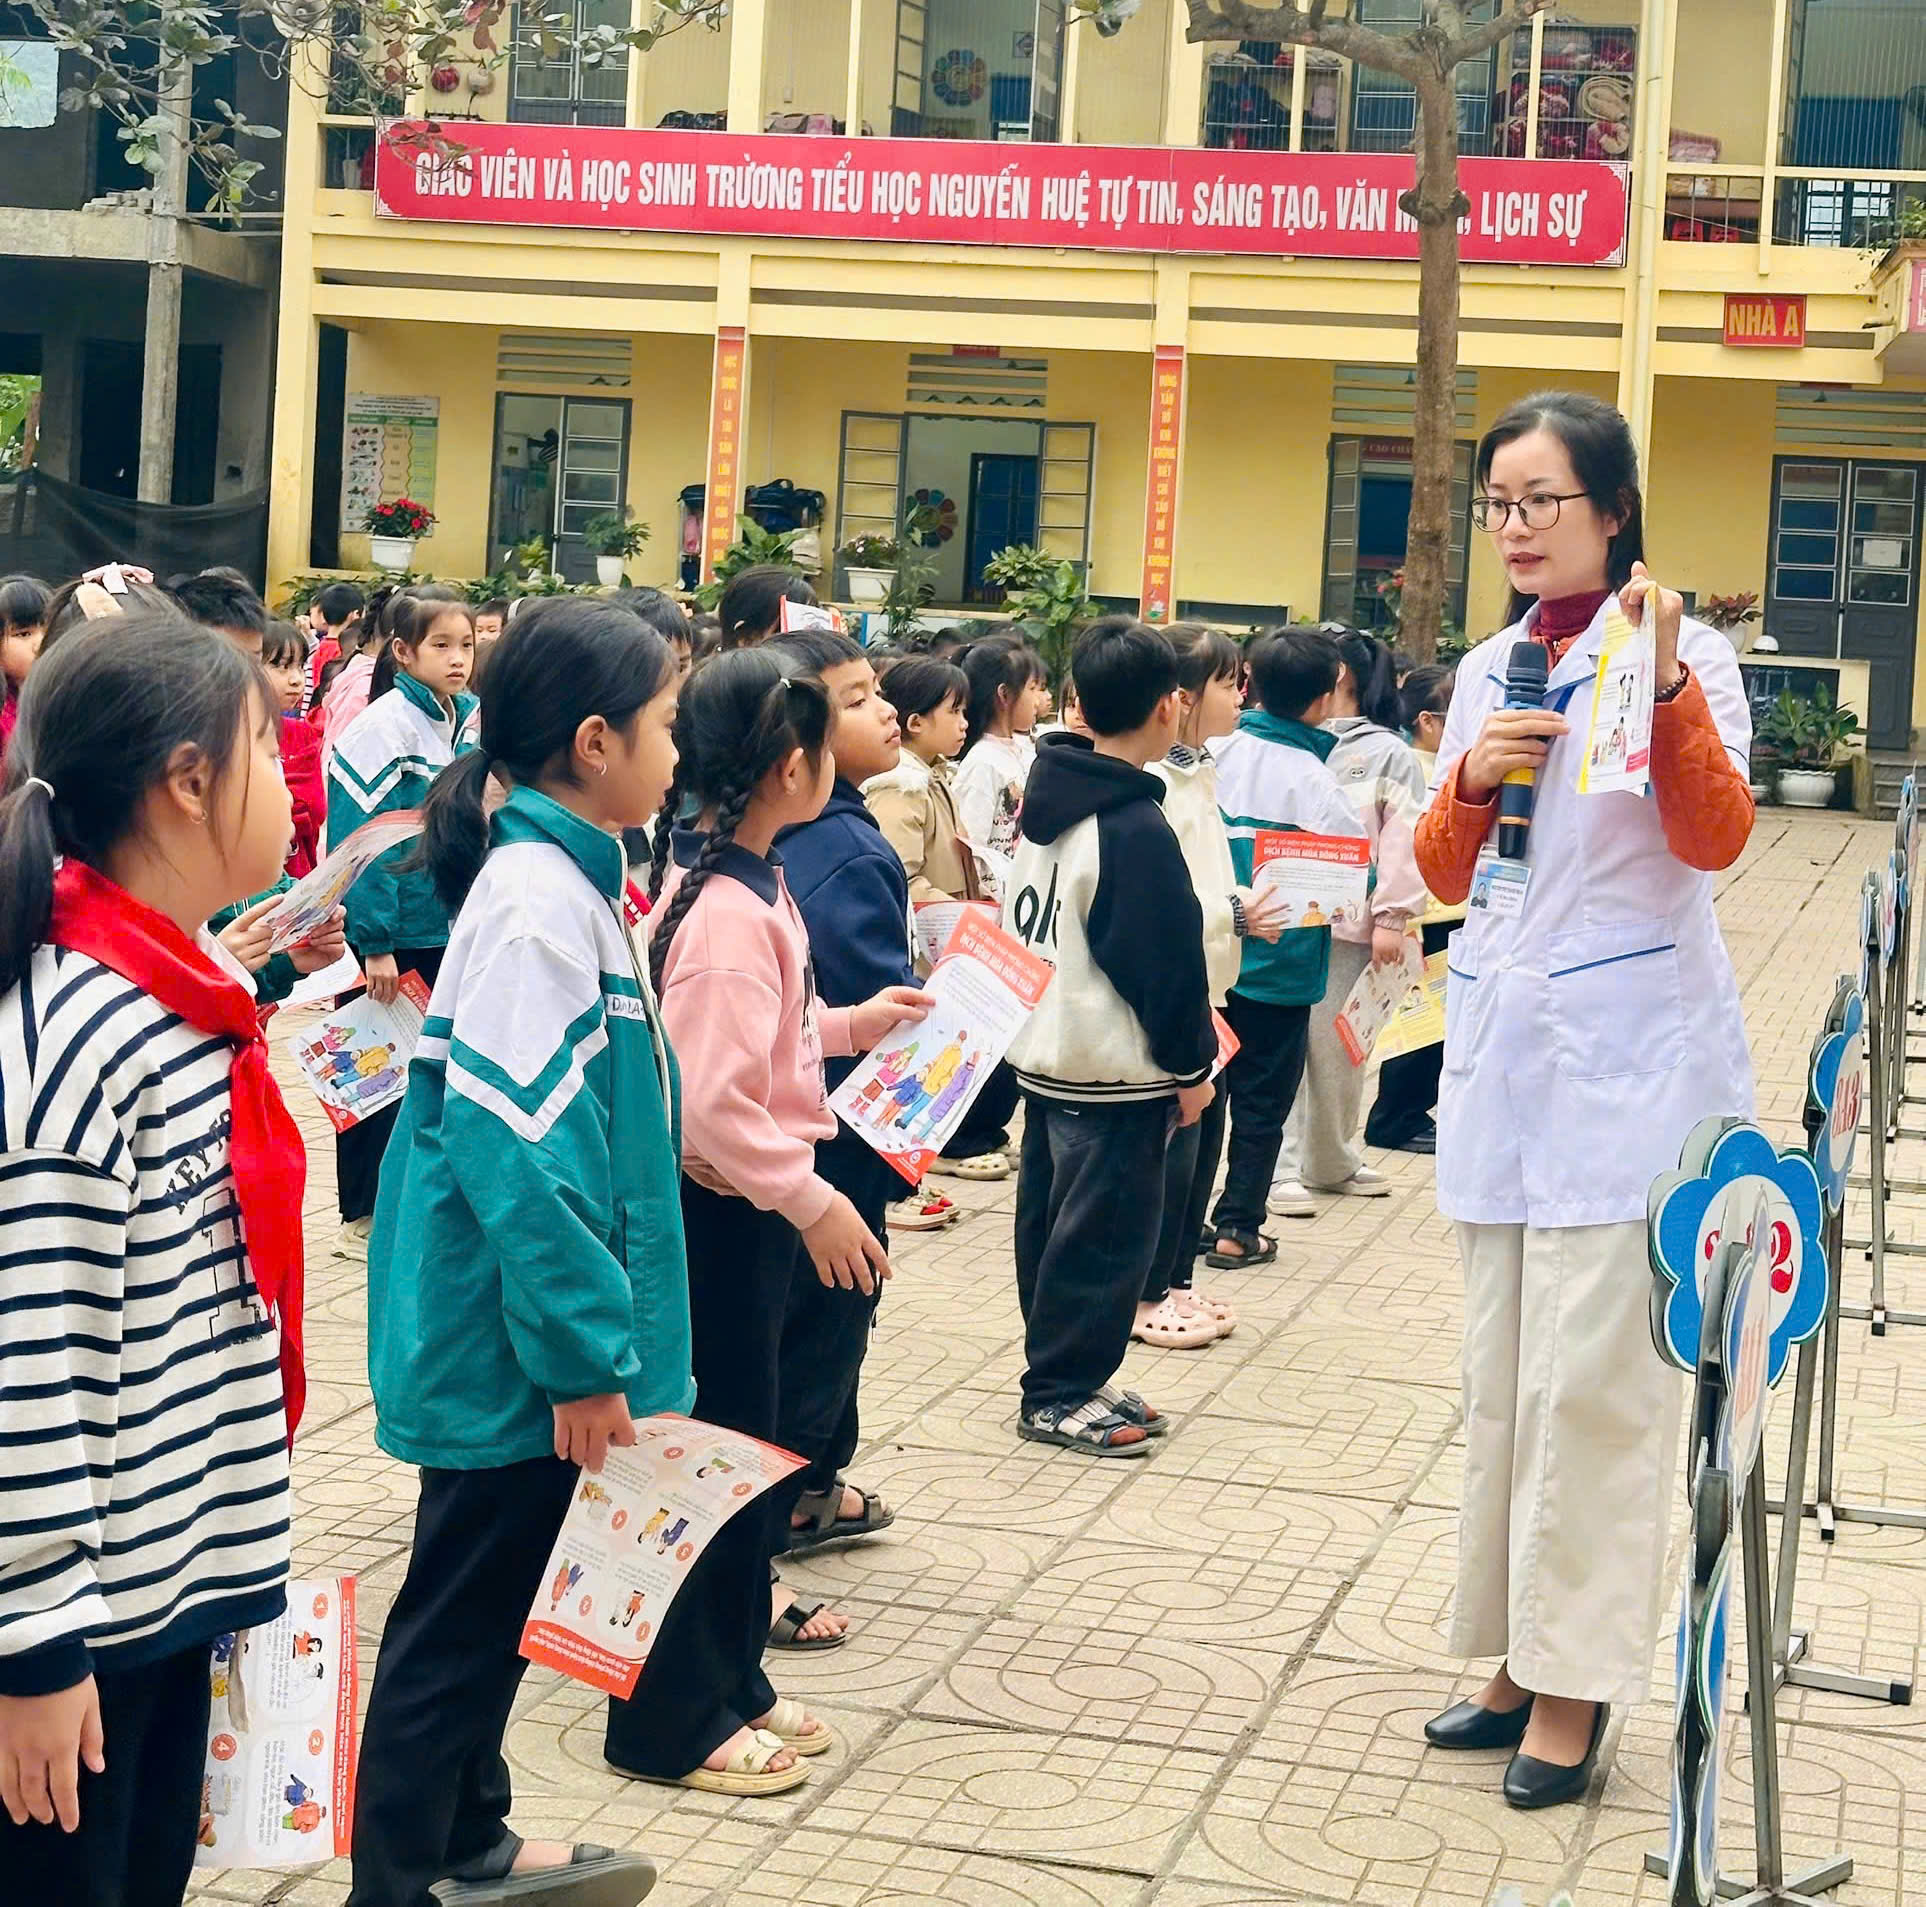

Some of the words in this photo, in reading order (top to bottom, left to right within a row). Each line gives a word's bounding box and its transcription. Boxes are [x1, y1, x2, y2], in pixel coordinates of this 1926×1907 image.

[481, 148, 536, 199] VIÊN
[544, 149, 573, 201] VÀ
[581, 159, 630, 211] HỌC
[638, 162, 696, 206] SINH
[706, 154, 803, 211] TRƯỜNG
[811, 151, 864, 213] TIỂU
[871, 171, 922, 223] HỌC
[929, 163, 1031, 220] NGUYỄN
[1041, 170, 1090, 229] HUỆ
[1099, 175, 1133, 231] TỰ
[1136, 180, 1183, 225] TIN,
[1192, 175, 1262, 228] SÁNG
[1272, 185, 1327, 236] TẠO,
[1337, 179, 1387, 232] VĂN
[1481, 191, 1539, 243] LỊCH
[1548, 190, 1588, 247] SỰ
[1729, 298, 1776, 337] NHÀ
[1784, 305, 1799, 337] A
